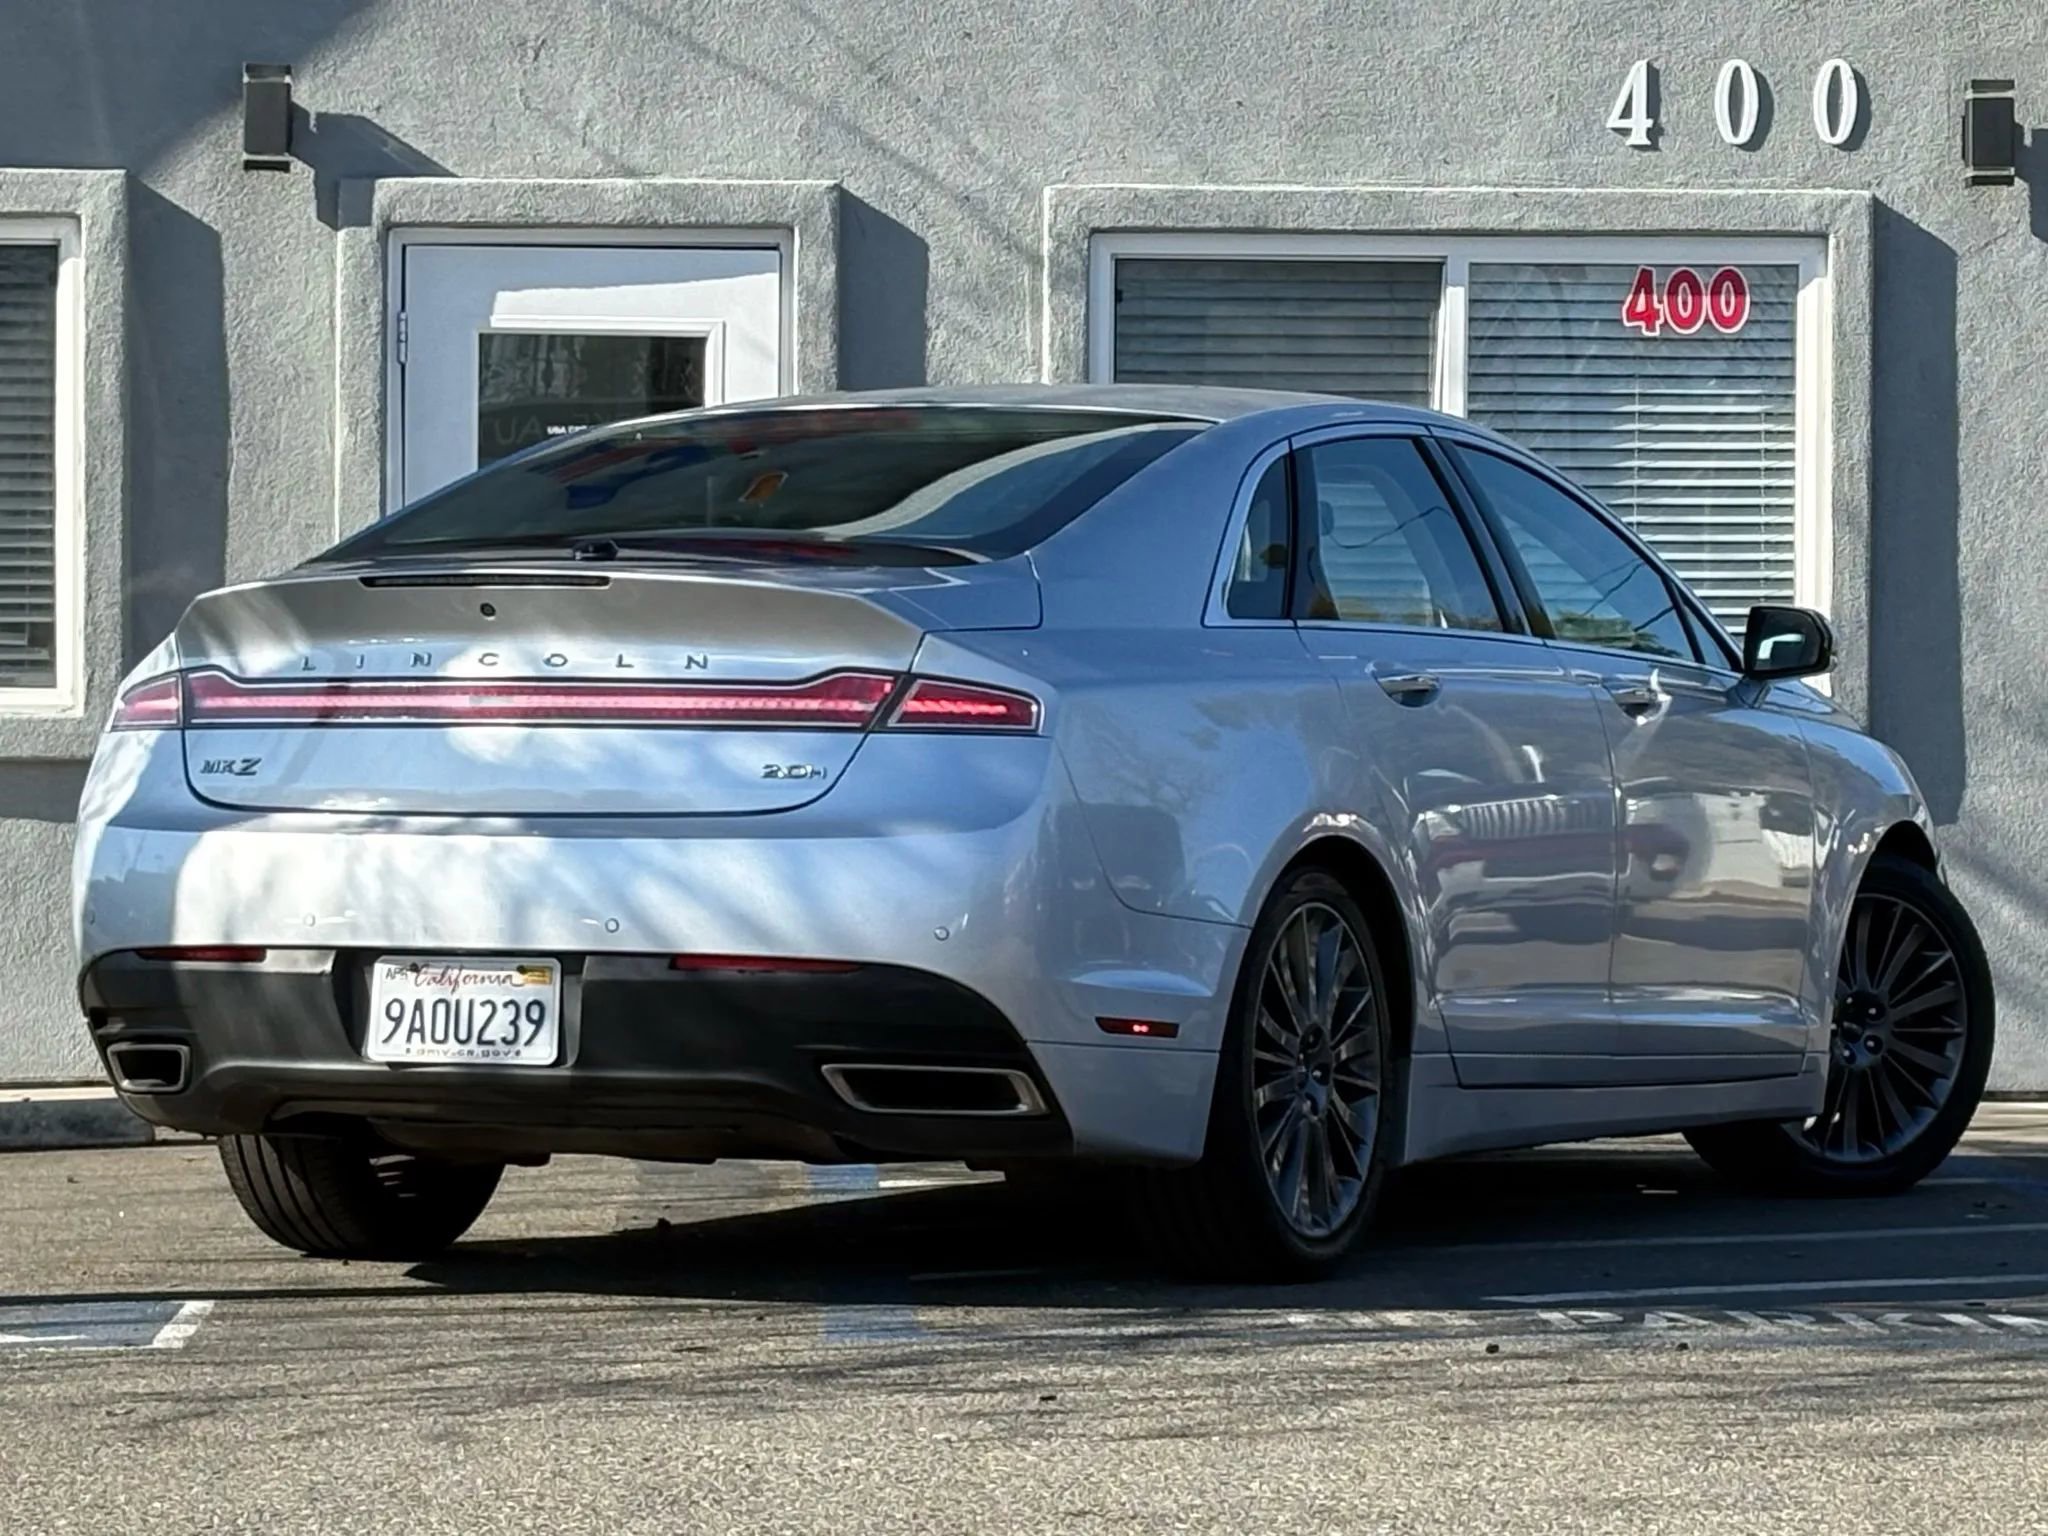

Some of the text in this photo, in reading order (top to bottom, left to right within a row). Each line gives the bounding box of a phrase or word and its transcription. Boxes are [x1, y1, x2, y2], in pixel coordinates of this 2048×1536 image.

[1606, 58, 1857, 146] 400
[1621, 265, 1751, 336] 400
[301, 652, 708, 671] LINCOLN
[200, 758, 262, 776] MKZ
[414, 963, 525, 995] California
